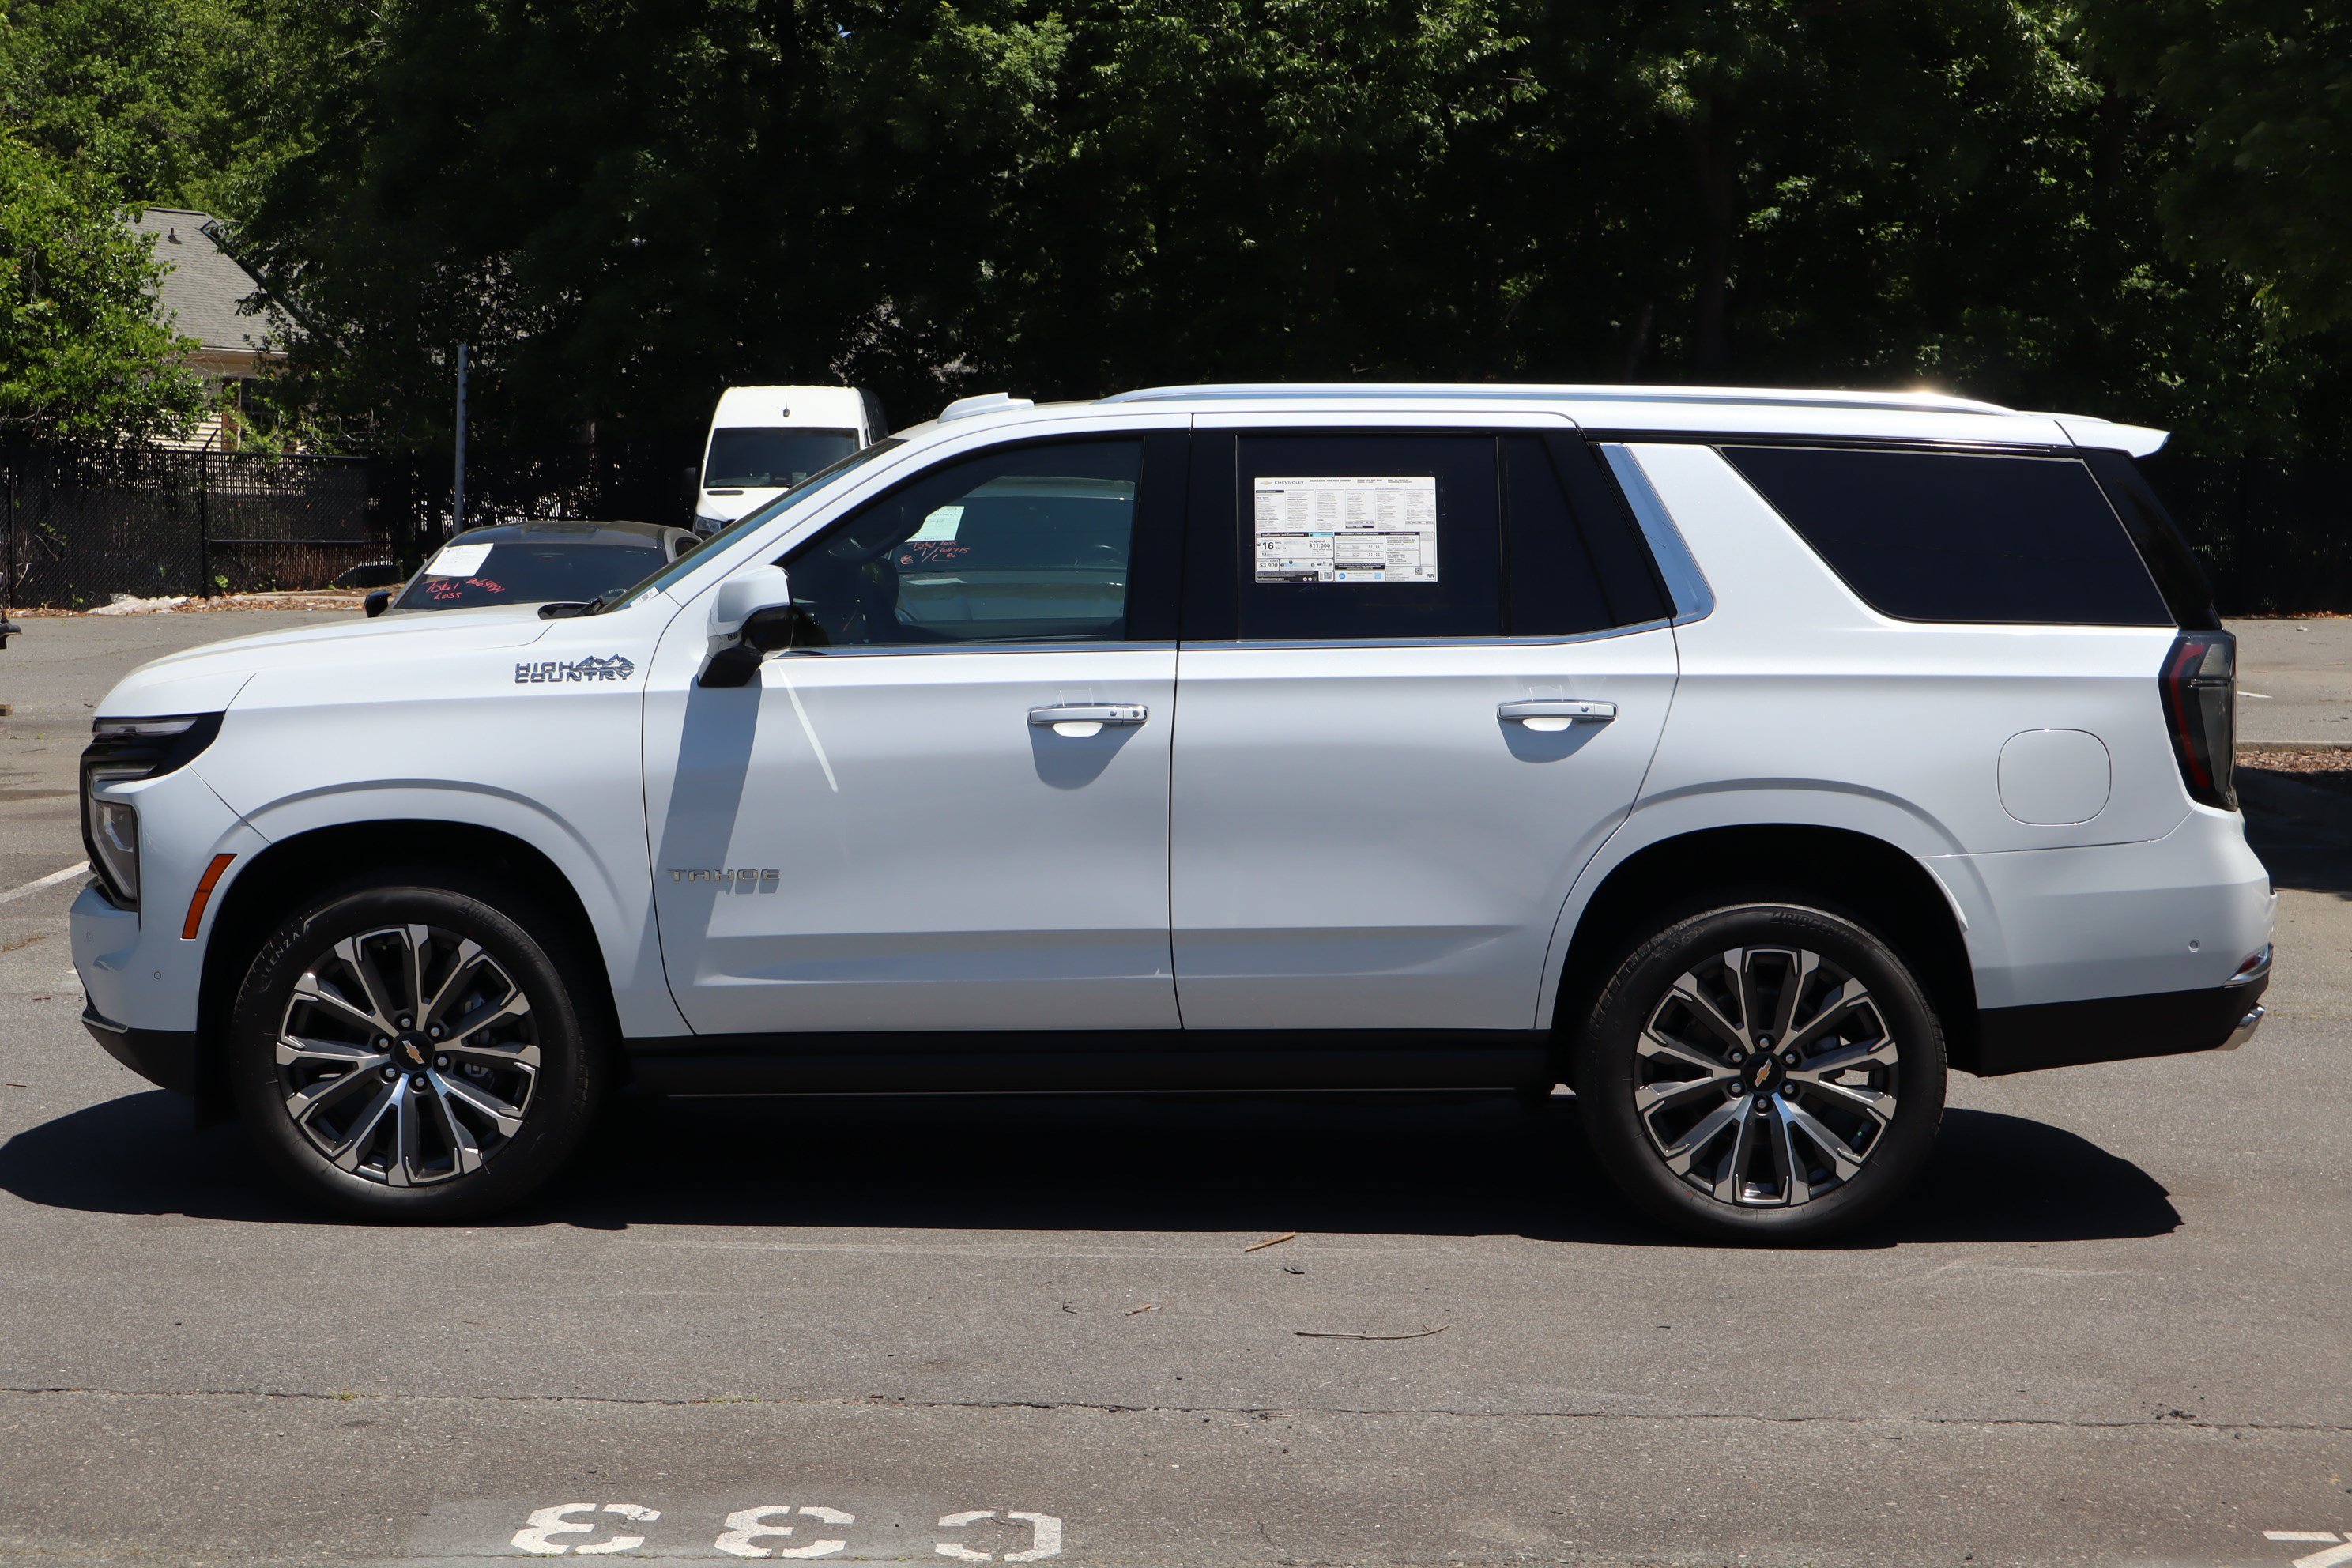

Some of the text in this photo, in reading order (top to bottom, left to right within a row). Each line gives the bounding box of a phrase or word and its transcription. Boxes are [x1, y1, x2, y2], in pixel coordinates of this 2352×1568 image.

[1262, 541, 1274, 550] 16
[422, 579, 459, 593] Total
[515, 662, 574, 674] HIGH
[514, 670, 635, 684] COUNTRY
[666, 868, 781, 882] TAHOE
